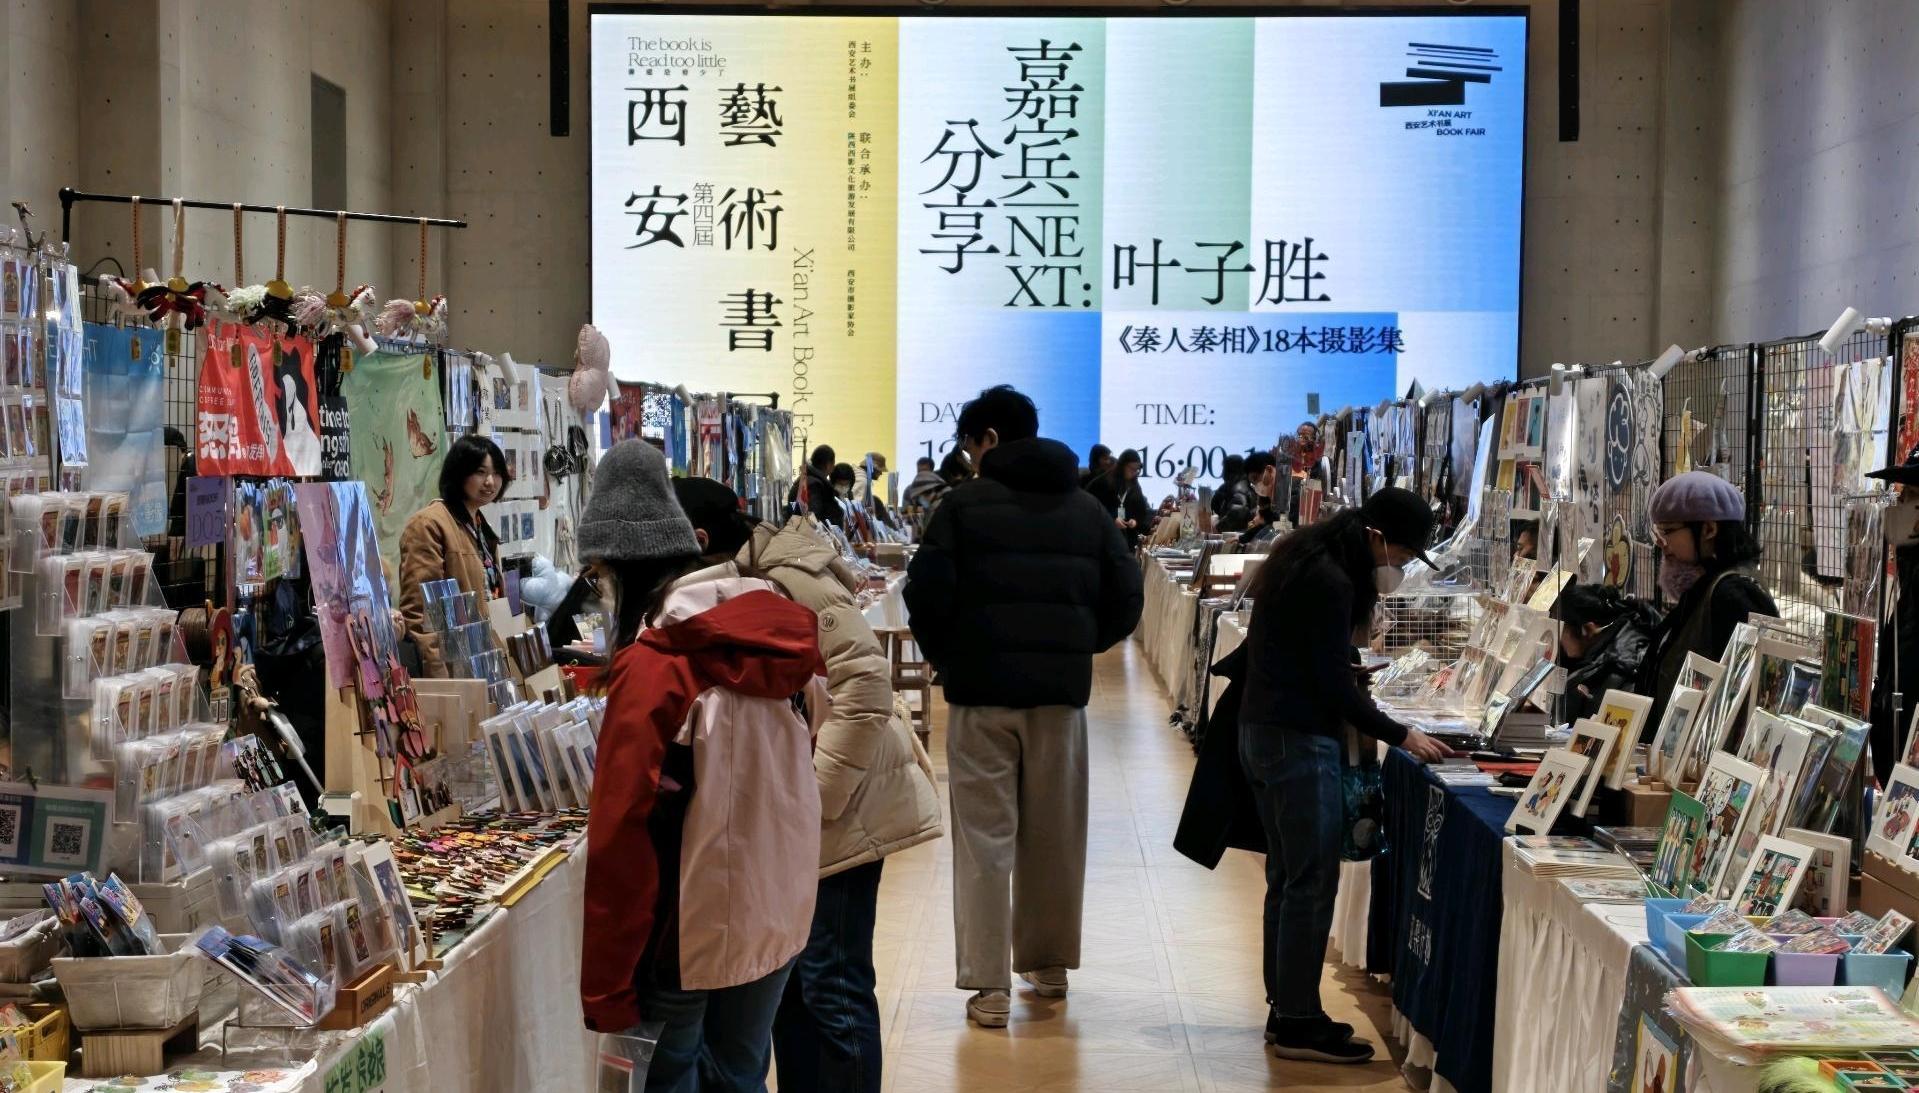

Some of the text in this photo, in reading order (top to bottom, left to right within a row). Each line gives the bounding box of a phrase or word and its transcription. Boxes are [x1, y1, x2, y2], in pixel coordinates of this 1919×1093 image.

[628, 36, 712, 51] The book is
[628, 53, 727, 68] Read too little
[1427, 109, 1473, 119] XI'AN ART
[1436, 128, 1487, 136] BOOK FAIR
[692, 182, 715, 247] 第四屆
[918, 117, 1005, 275] 分享
[1005, 215, 1084, 258] NE
[792, 247, 815, 301] Xi'an
[1004, 264, 1092, 308] XT:
[1113, 236, 1331, 306] 叶子胜
[792, 303, 815, 339] Art
[1118, 324, 1406, 355] 《秦人秦相》18本摄影集
[792, 346, 815, 406] Book
[1136, 403, 1215, 425] TIME:
